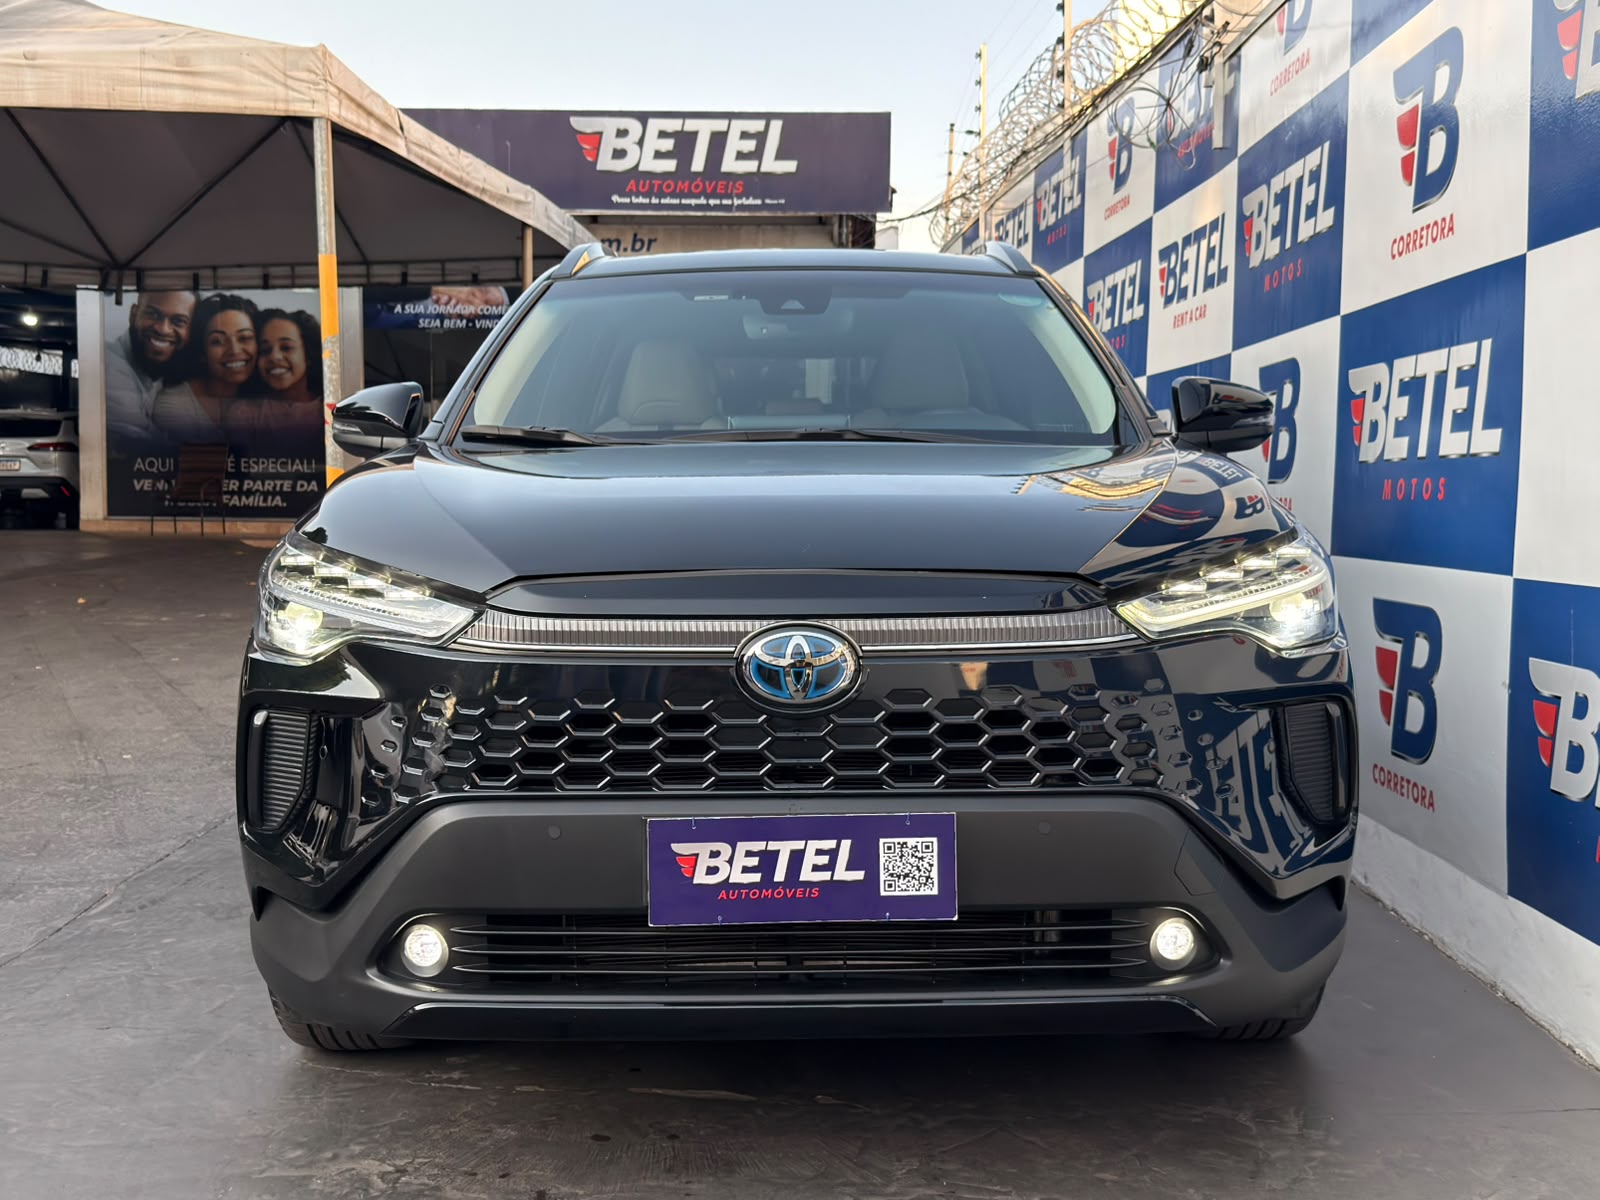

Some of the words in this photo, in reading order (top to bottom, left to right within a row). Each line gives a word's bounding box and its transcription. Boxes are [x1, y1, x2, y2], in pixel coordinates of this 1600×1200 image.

[1269, 48, 1310, 97] CORRETORA
[569, 116, 798, 174] BETEL
[625, 178, 745, 193] AUTOMÓVEIS
[1242, 141, 1335, 269] BETEL
[1390, 213, 1455, 260] CORRETORA
[1158, 212, 1229, 309] BETEL
[1263, 258, 1303, 293] MOTOS
[394, 304, 402, 314] A
[404, 304, 425, 314] SUA
[427, 304, 475, 314] JORNADA
[1087, 259, 1145, 333] BETEL
[418, 319, 441, 328] SEJA
[443, 319, 466, 328] BEM
[1173, 311, 1189, 329] RENT
[1189, 309, 1195, 325] A
[1196, 304, 1208, 323] CAR
[1348, 338, 1502, 464] BETEL
[133, 457, 174, 473] AQUI
[241, 458, 316, 472] ESPECIAL!
[243, 480, 293, 491] PARTE
[301, 480, 319, 491] DA
[1382, 477, 1447, 501] MOTOS
[1372, 763, 1436, 814] CORRETORA
[670, 839, 866, 885] BETEL
[717, 886, 820, 901] AUTOMÓVEIS
